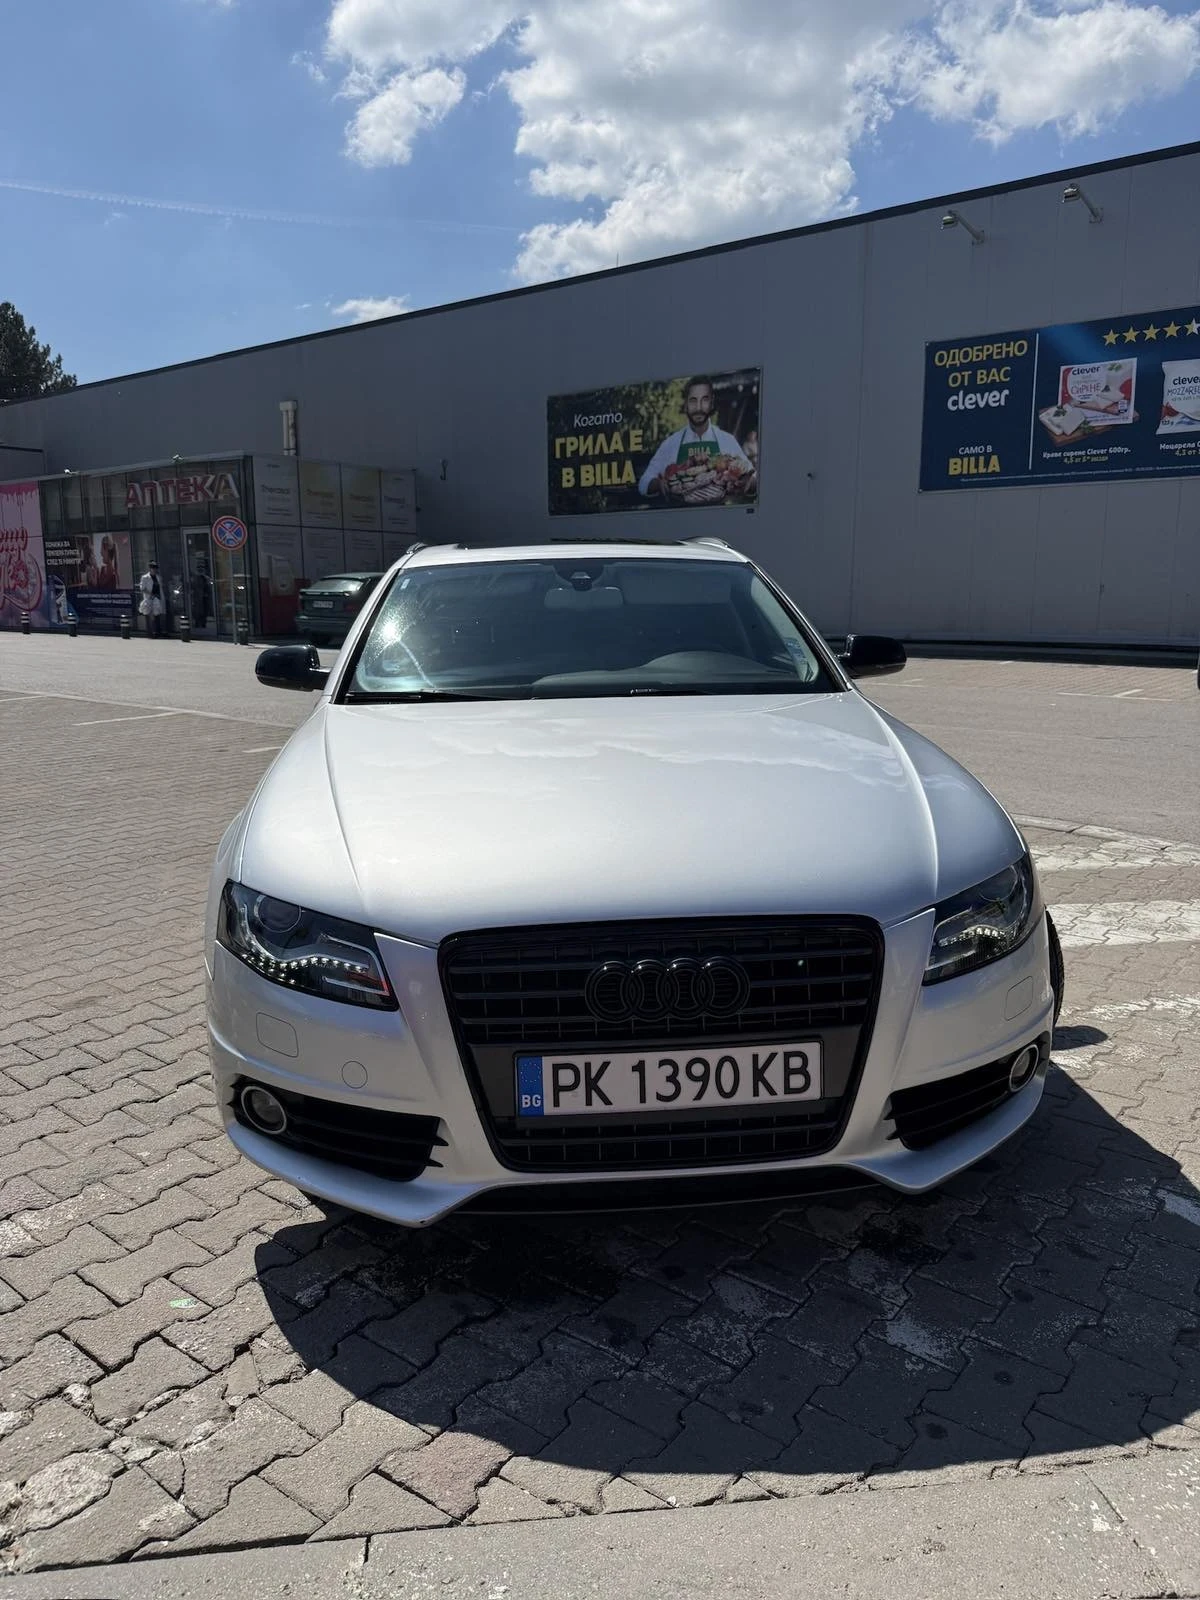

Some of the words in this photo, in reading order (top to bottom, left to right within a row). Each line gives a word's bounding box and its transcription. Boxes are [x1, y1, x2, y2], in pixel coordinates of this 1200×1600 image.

[934, 340, 1028, 368] ОДОБРЕНО
[948, 371, 971, 388] ОТ
[976, 367, 1011, 386] ВАС
[1071, 365, 1101, 376] clever
[1173, 375, 1200, 386] cleve
[947, 388, 1010, 411] clever
[573, 411, 623, 428] Когато
[554, 431, 625, 459] ГРИЛА
[630, 430, 643, 452] Е
[688, 446, 711, 457] BILLA
[958, 446, 985, 456] САМО
[986, 445, 993, 453] В
[1086, 448, 1108, 456] Clever
[581, 460, 636, 488] BILLA
[948, 455, 1001, 476] BILLA
[125, 473, 240, 508] АПТЕКА
[552, 1061, 613, 1107] PK
[632, 1055, 740, 1104] 1390
[752, 1050, 811, 1097] KB
[521, 1094, 542, 1108] BG
